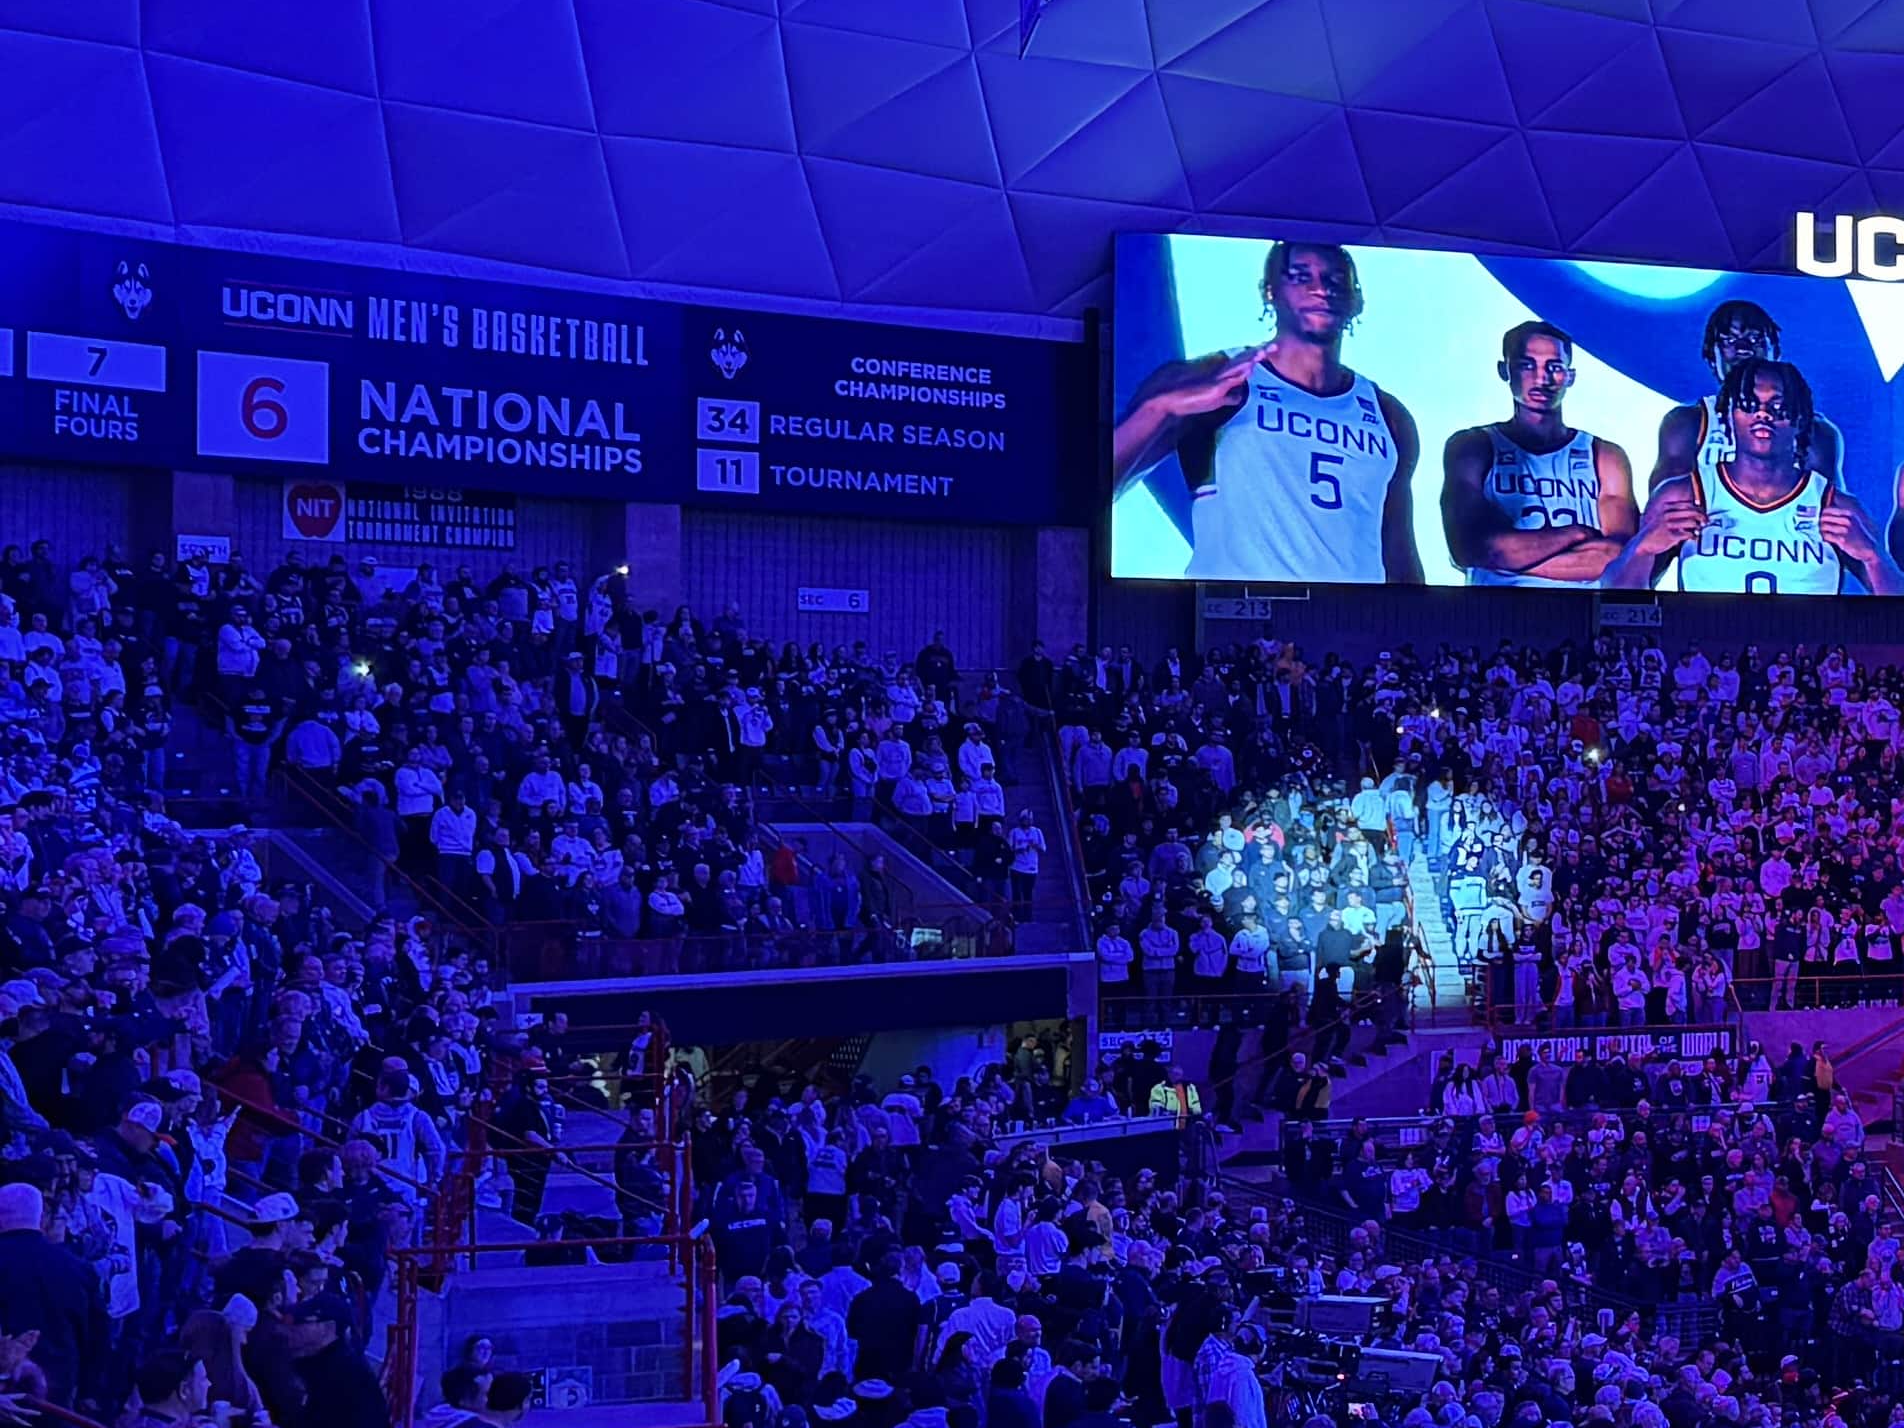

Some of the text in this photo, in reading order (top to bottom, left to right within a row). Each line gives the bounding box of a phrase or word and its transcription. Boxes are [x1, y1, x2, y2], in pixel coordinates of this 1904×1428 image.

[222, 287, 649, 366] UCONN MEN'S BASKETBALL
[87, 346, 108, 377] 7
[851, 357, 992, 385] CONFERENCE
[55, 389, 139, 418] FINAL
[241, 377, 289, 441] 6
[834, 380, 1007, 410] CHAMPIONSHIPS
[360, 379, 641, 442] NATIONAL
[55, 416, 139, 442] FOURS
[706, 406, 1005, 452] 34 REGULAR SEASON
[1256, 404, 1389, 460] UCONN
[358, 427, 643, 474] CHAMPIONSHIPS
[715, 458, 954, 497] 11 TOURNAMENT
[1309, 451, 1345, 510] 5
[1494, 471, 1598, 501] UCONN
[296, 498, 335, 519] NIT
[1697, 535, 1823, 565] UCONN
[848, 591, 861, 608] 6
[1235, 600, 1270, 618] 213
[1627, 608, 1660, 625] 214
